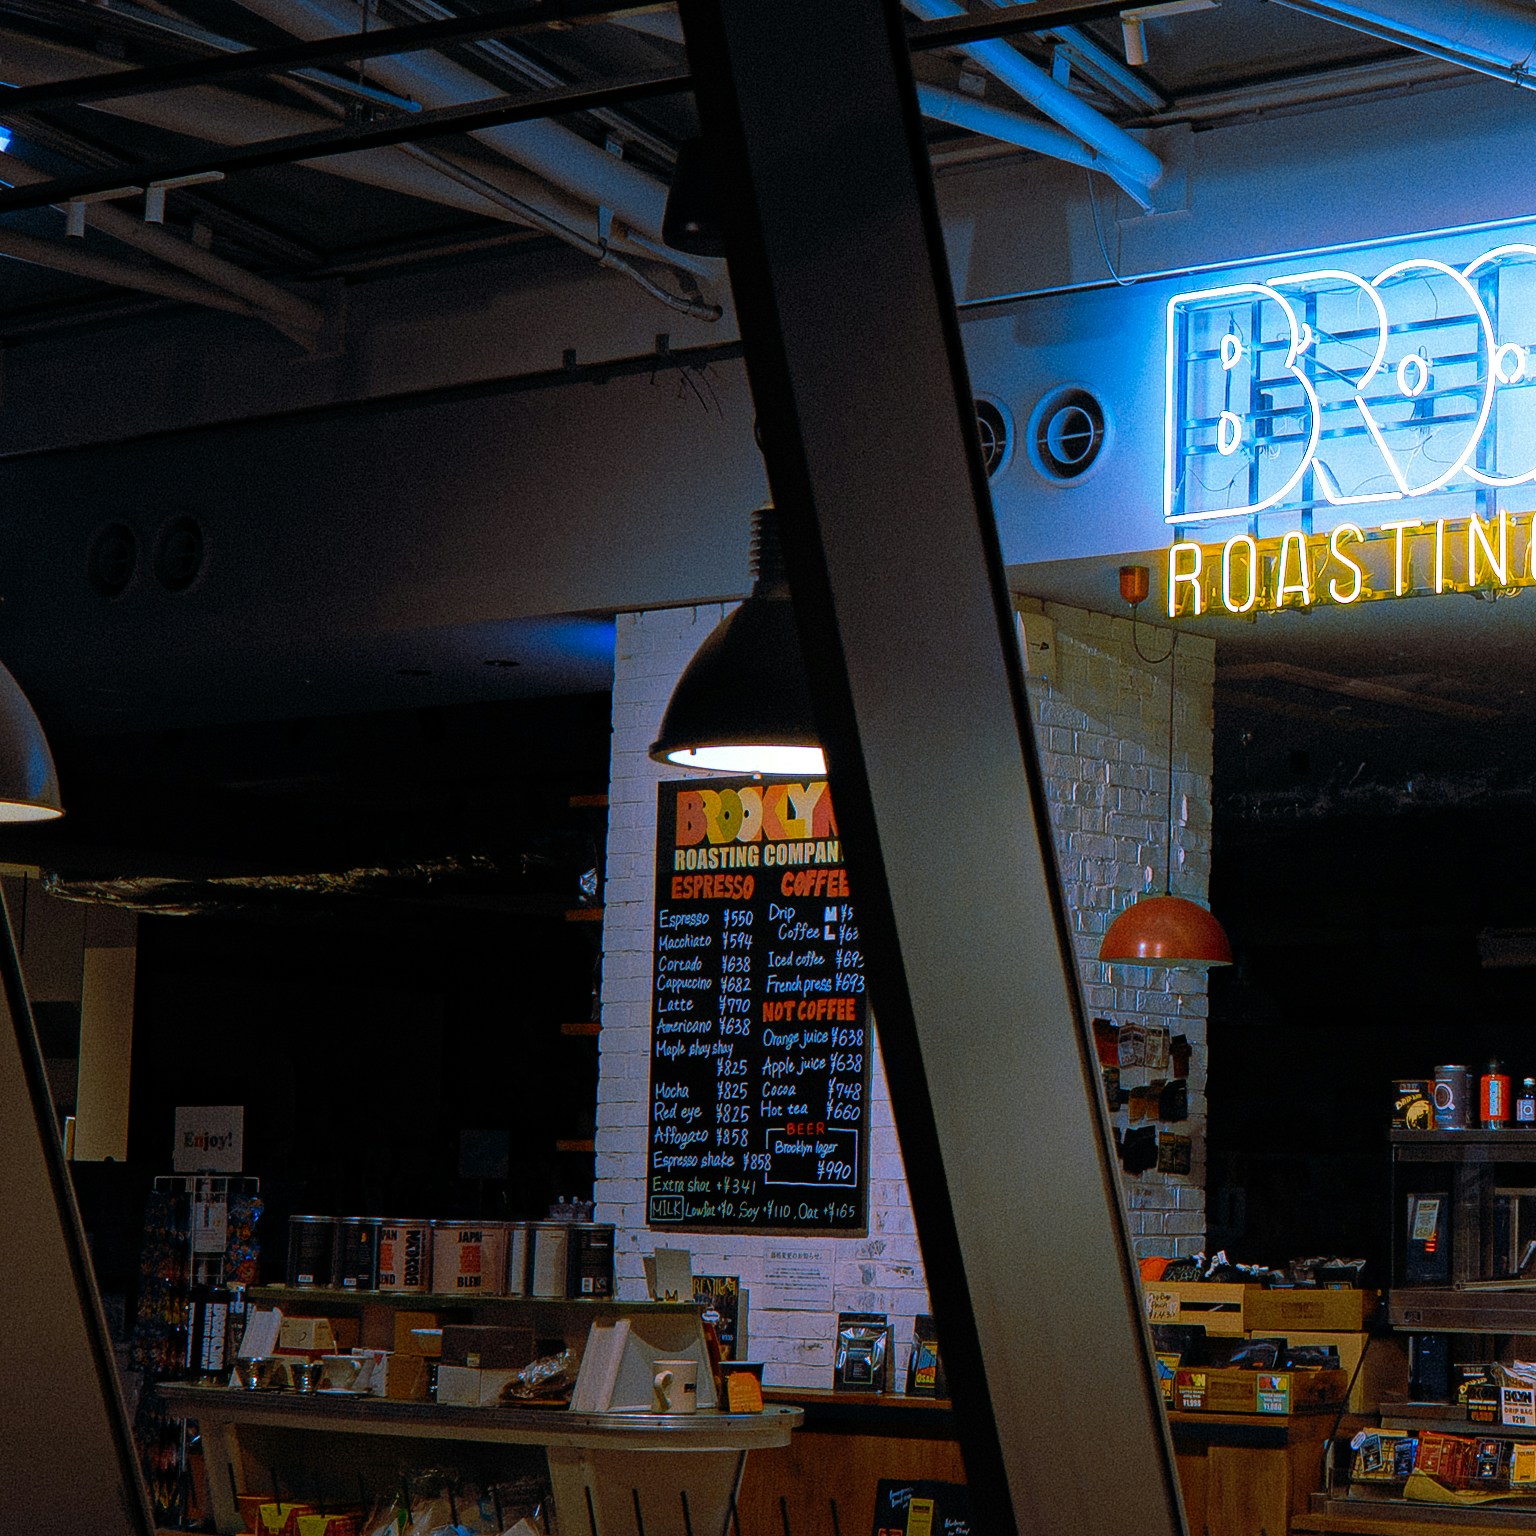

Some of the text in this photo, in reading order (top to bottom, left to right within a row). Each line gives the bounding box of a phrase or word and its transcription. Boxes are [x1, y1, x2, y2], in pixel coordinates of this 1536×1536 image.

[674, 840, 844, 871] ROASTING COMPAN
[671, 874, 755, 900] ESPRESSO
[659, 909, 710, 928] Espresso
[768, 902, 796, 923] Drip
[778, 922, 820, 941] Coffee
[823, 924, 836, 941] L
[658, 933, 711, 951] Macchiato
[658, 955, 702, 972] Cortado
[767, 950, 793, 967] Iced
[795, 950, 825, 967] coffee
[657, 975, 712, 998] Cappuccino
[657, 997, 694, 1014] Latte
[763, 997, 856, 1022] NOT COFFEE
[656, 1018, 712, 1035] Americano
[762, 1028, 800, 1051] Orange
[799, 1029, 829, 1049] juice
[656, 1040, 686, 1061] Maple
[761, 1057, 795, 1079] Apple
[796, 1056, 826, 1076] juice
[655, 1082, 689, 1100] Mocha
[762, 1081, 797, 1098] Cocoa
[654, 1101, 677, 1122] Red
[680, 1108, 703, 1124] eye
[760, 1100, 783, 1118] Hot
[787, 1103, 809, 1116] tea
[654, 1126, 709, 1150] Affogato
[786, 1121, 826, 1136] BEER
[183, 1131, 233, 1152] Enjoy!
[775, 1140, 839, 1159] Brooklyn lager
[653, 1151, 698, 1172] Espresso
[700, 1152, 735, 1168] shake
[652, 1176, 685, 1193] Extra
[687, 1176, 711, 1193] shot
[652, 1199, 681, 1216] MILK
